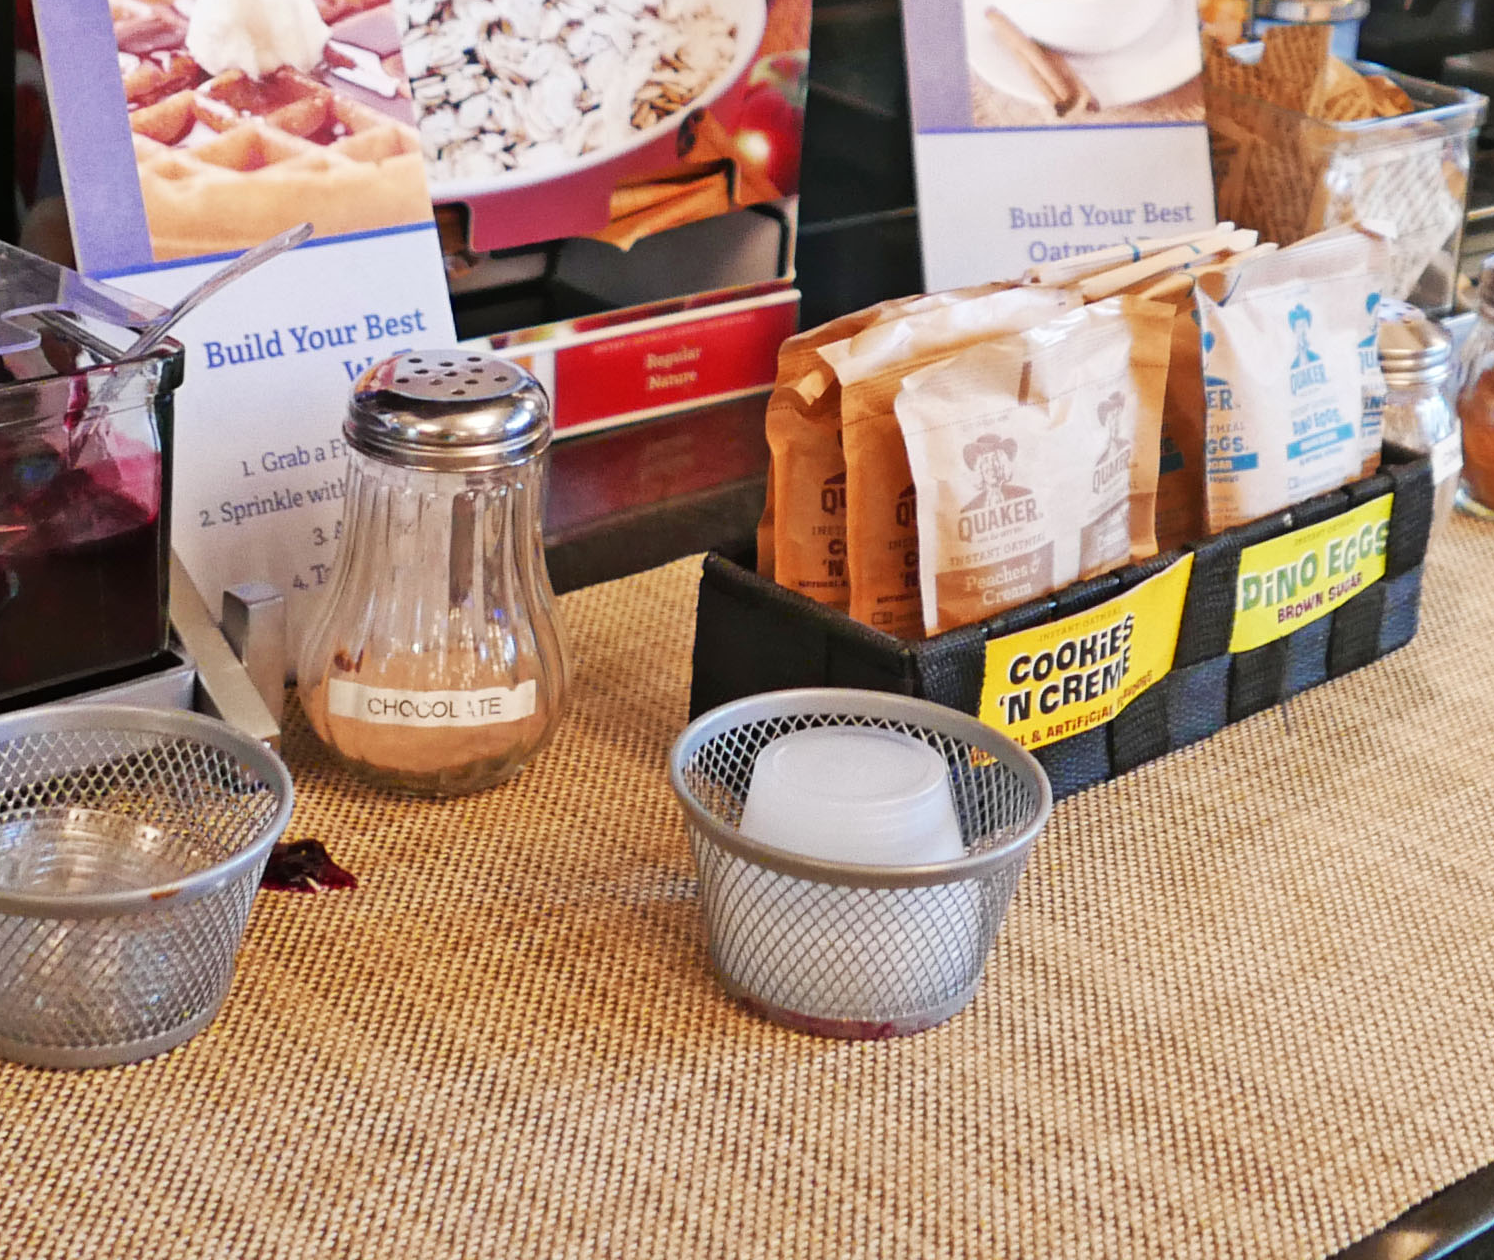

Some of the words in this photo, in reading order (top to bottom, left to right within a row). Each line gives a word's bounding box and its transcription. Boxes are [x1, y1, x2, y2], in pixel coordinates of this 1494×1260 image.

[1009, 204, 1073, 230] Build
[1078, 203, 1135, 227] Your
[1142, 201, 1194, 224] Best
[1028, 237, 1131, 263] Oatm
[204, 330, 284, 369] Build
[289, 323, 358, 353] Your
[365, 307, 427, 341] Best
[242, 460, 255, 477] 1.
[262, 445, 310, 472] Grab
[314, 447, 326, 463] a
[199, 510, 216, 528] 2.
[220, 488, 304, 526] Sprinkle
[958, 497, 1038, 544] QUAKER
[1327, 521, 1390, 578] EGGS
[965, 564, 1029, 592] Peaches
[983, 582, 1033, 606] Cream
[1277, 593, 1324, 624] BROWN
[1039, 645, 1131, 715] CREME
